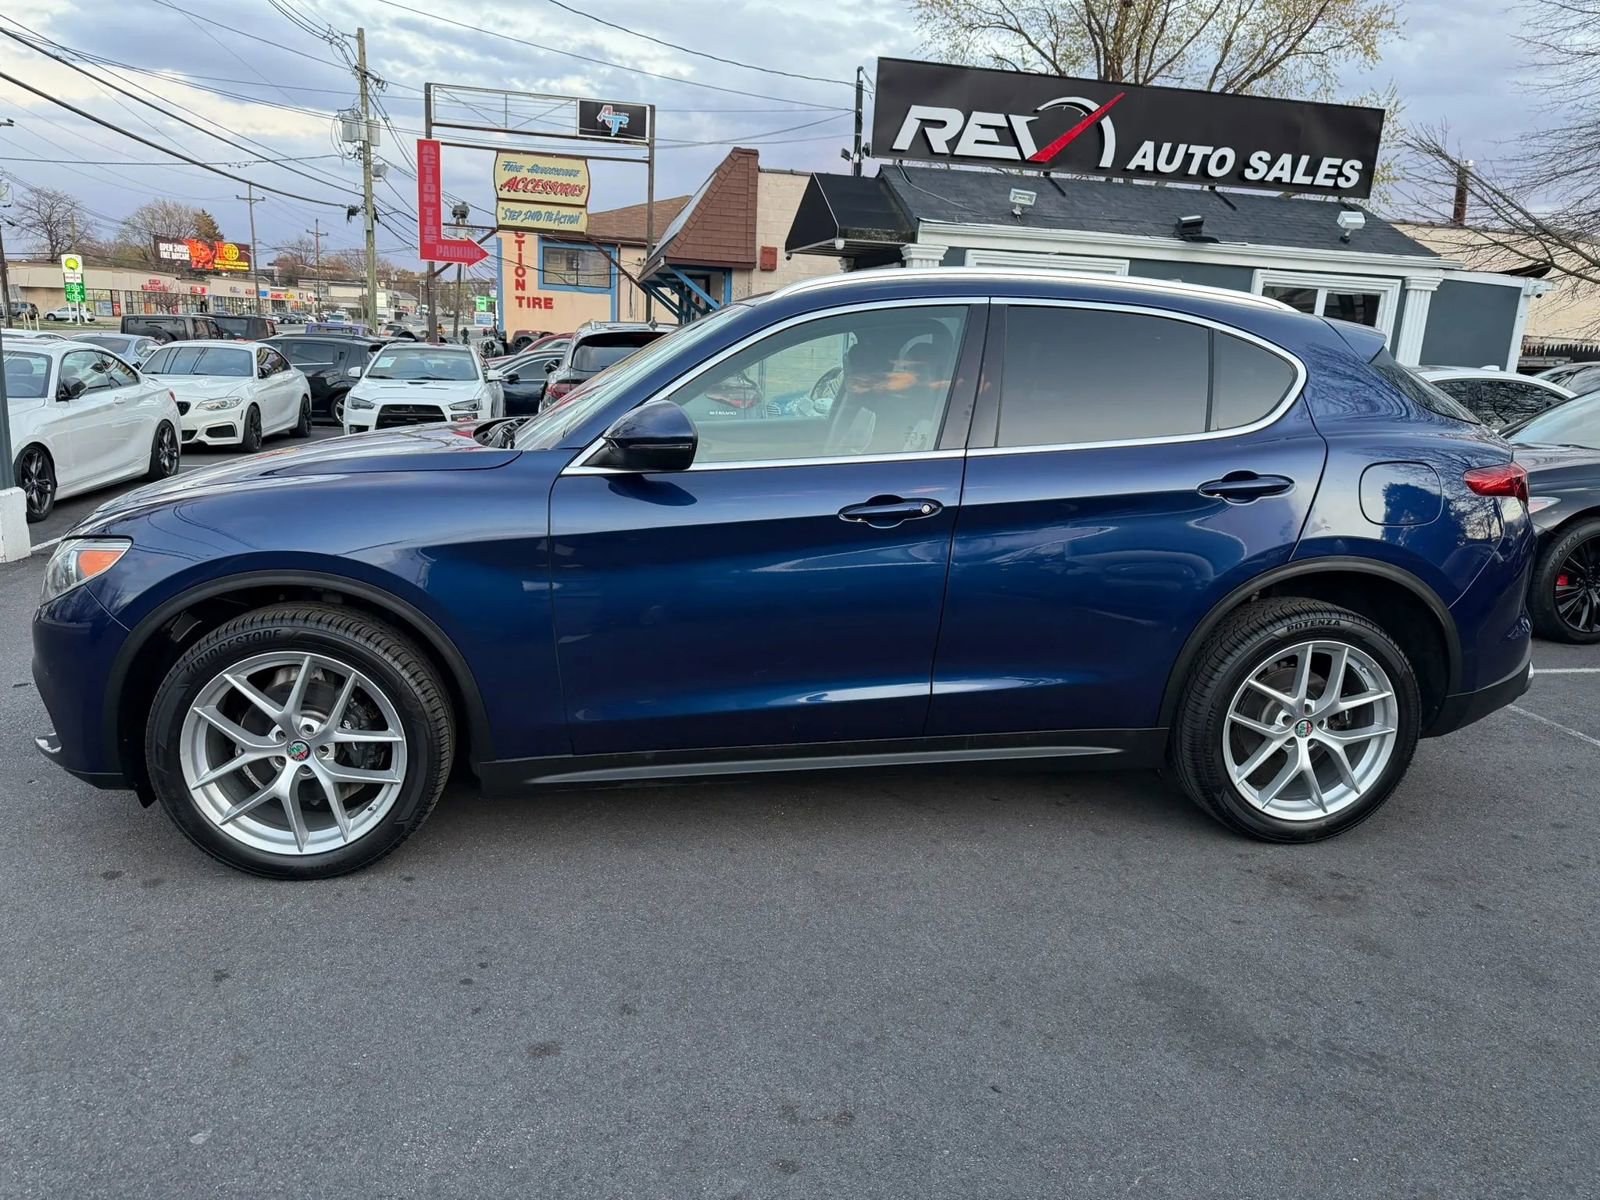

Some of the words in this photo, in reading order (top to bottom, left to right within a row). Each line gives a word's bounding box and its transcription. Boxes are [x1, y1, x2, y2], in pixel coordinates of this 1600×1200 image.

[1126, 140, 1236, 178] AUTO
[1244, 150, 1363, 189] SALES
[421, 145, 437, 203] ACTION
[500, 176, 585, 197] ACCESSORIES
[436, 245, 481, 259] PARKING
[515, 296, 554, 310] TIRE
[1287, 619, 1341, 632] POTENZA
